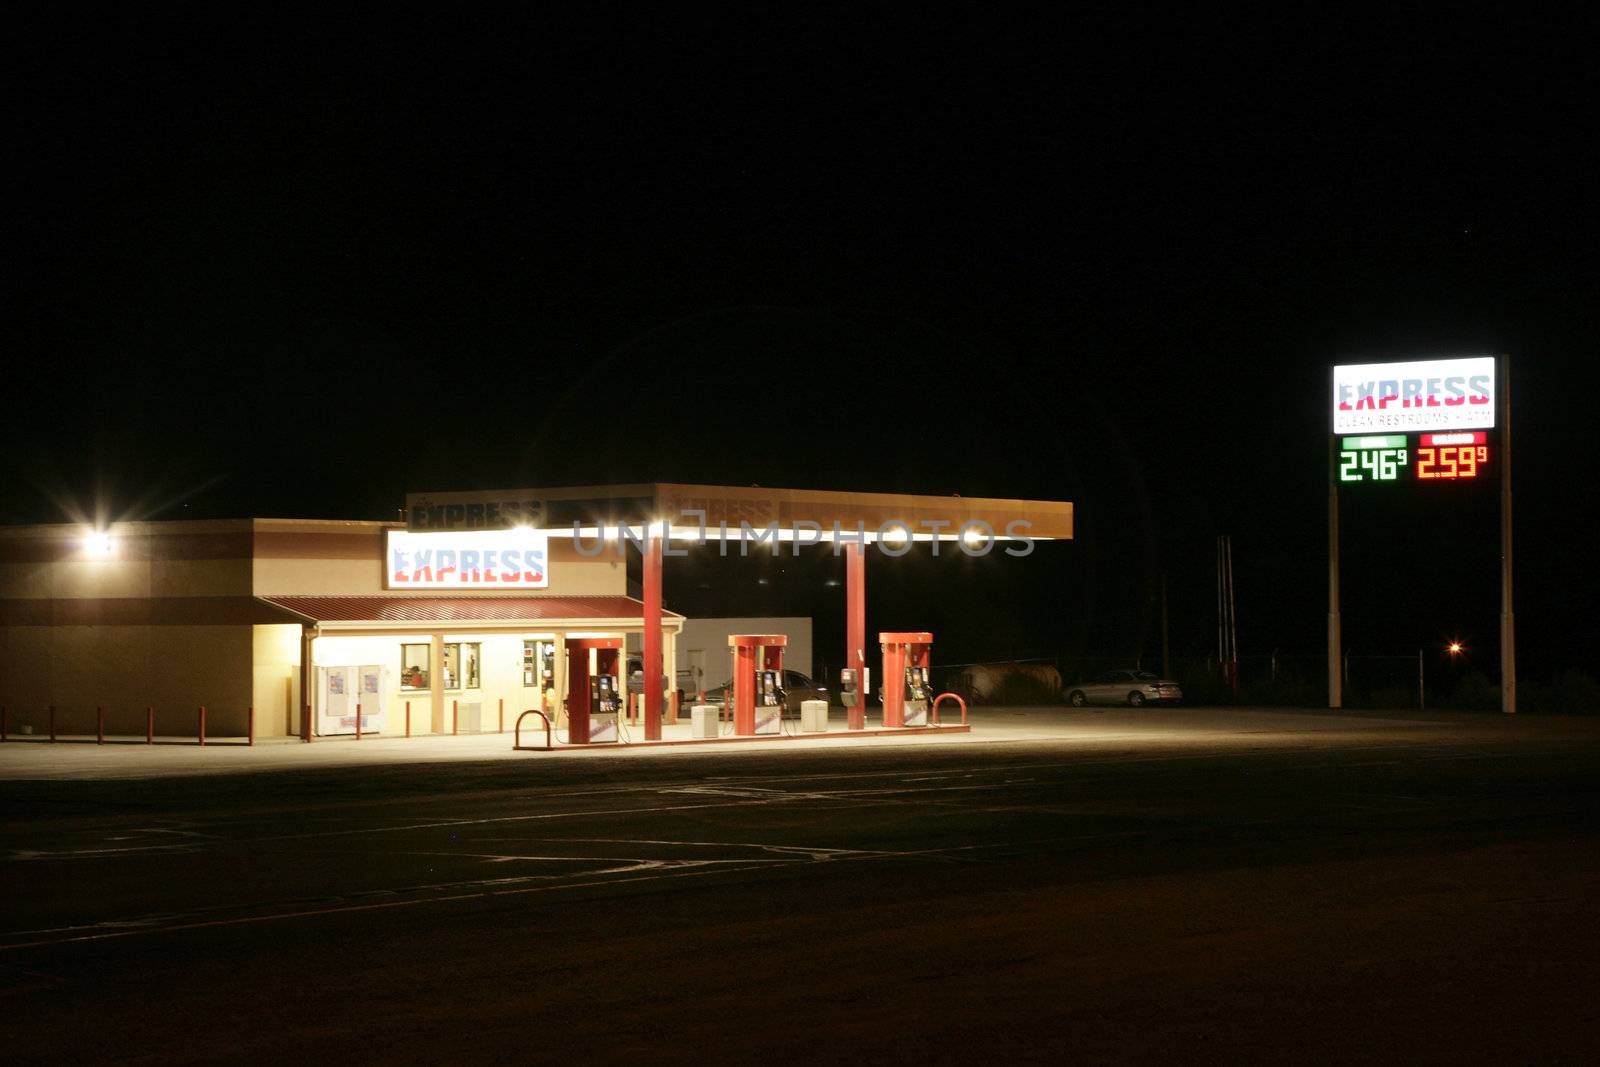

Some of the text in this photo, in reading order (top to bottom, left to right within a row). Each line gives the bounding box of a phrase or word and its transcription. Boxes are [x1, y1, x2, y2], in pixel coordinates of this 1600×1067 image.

[1338, 375, 1490, 410] EXPRESS
[1338, 415, 1373, 427] CLEAN
[1379, 412, 1449, 426] RESTROOMS
[411, 501, 541, 529] EXPRESS
[393, 548, 544, 583] EXPRESS
